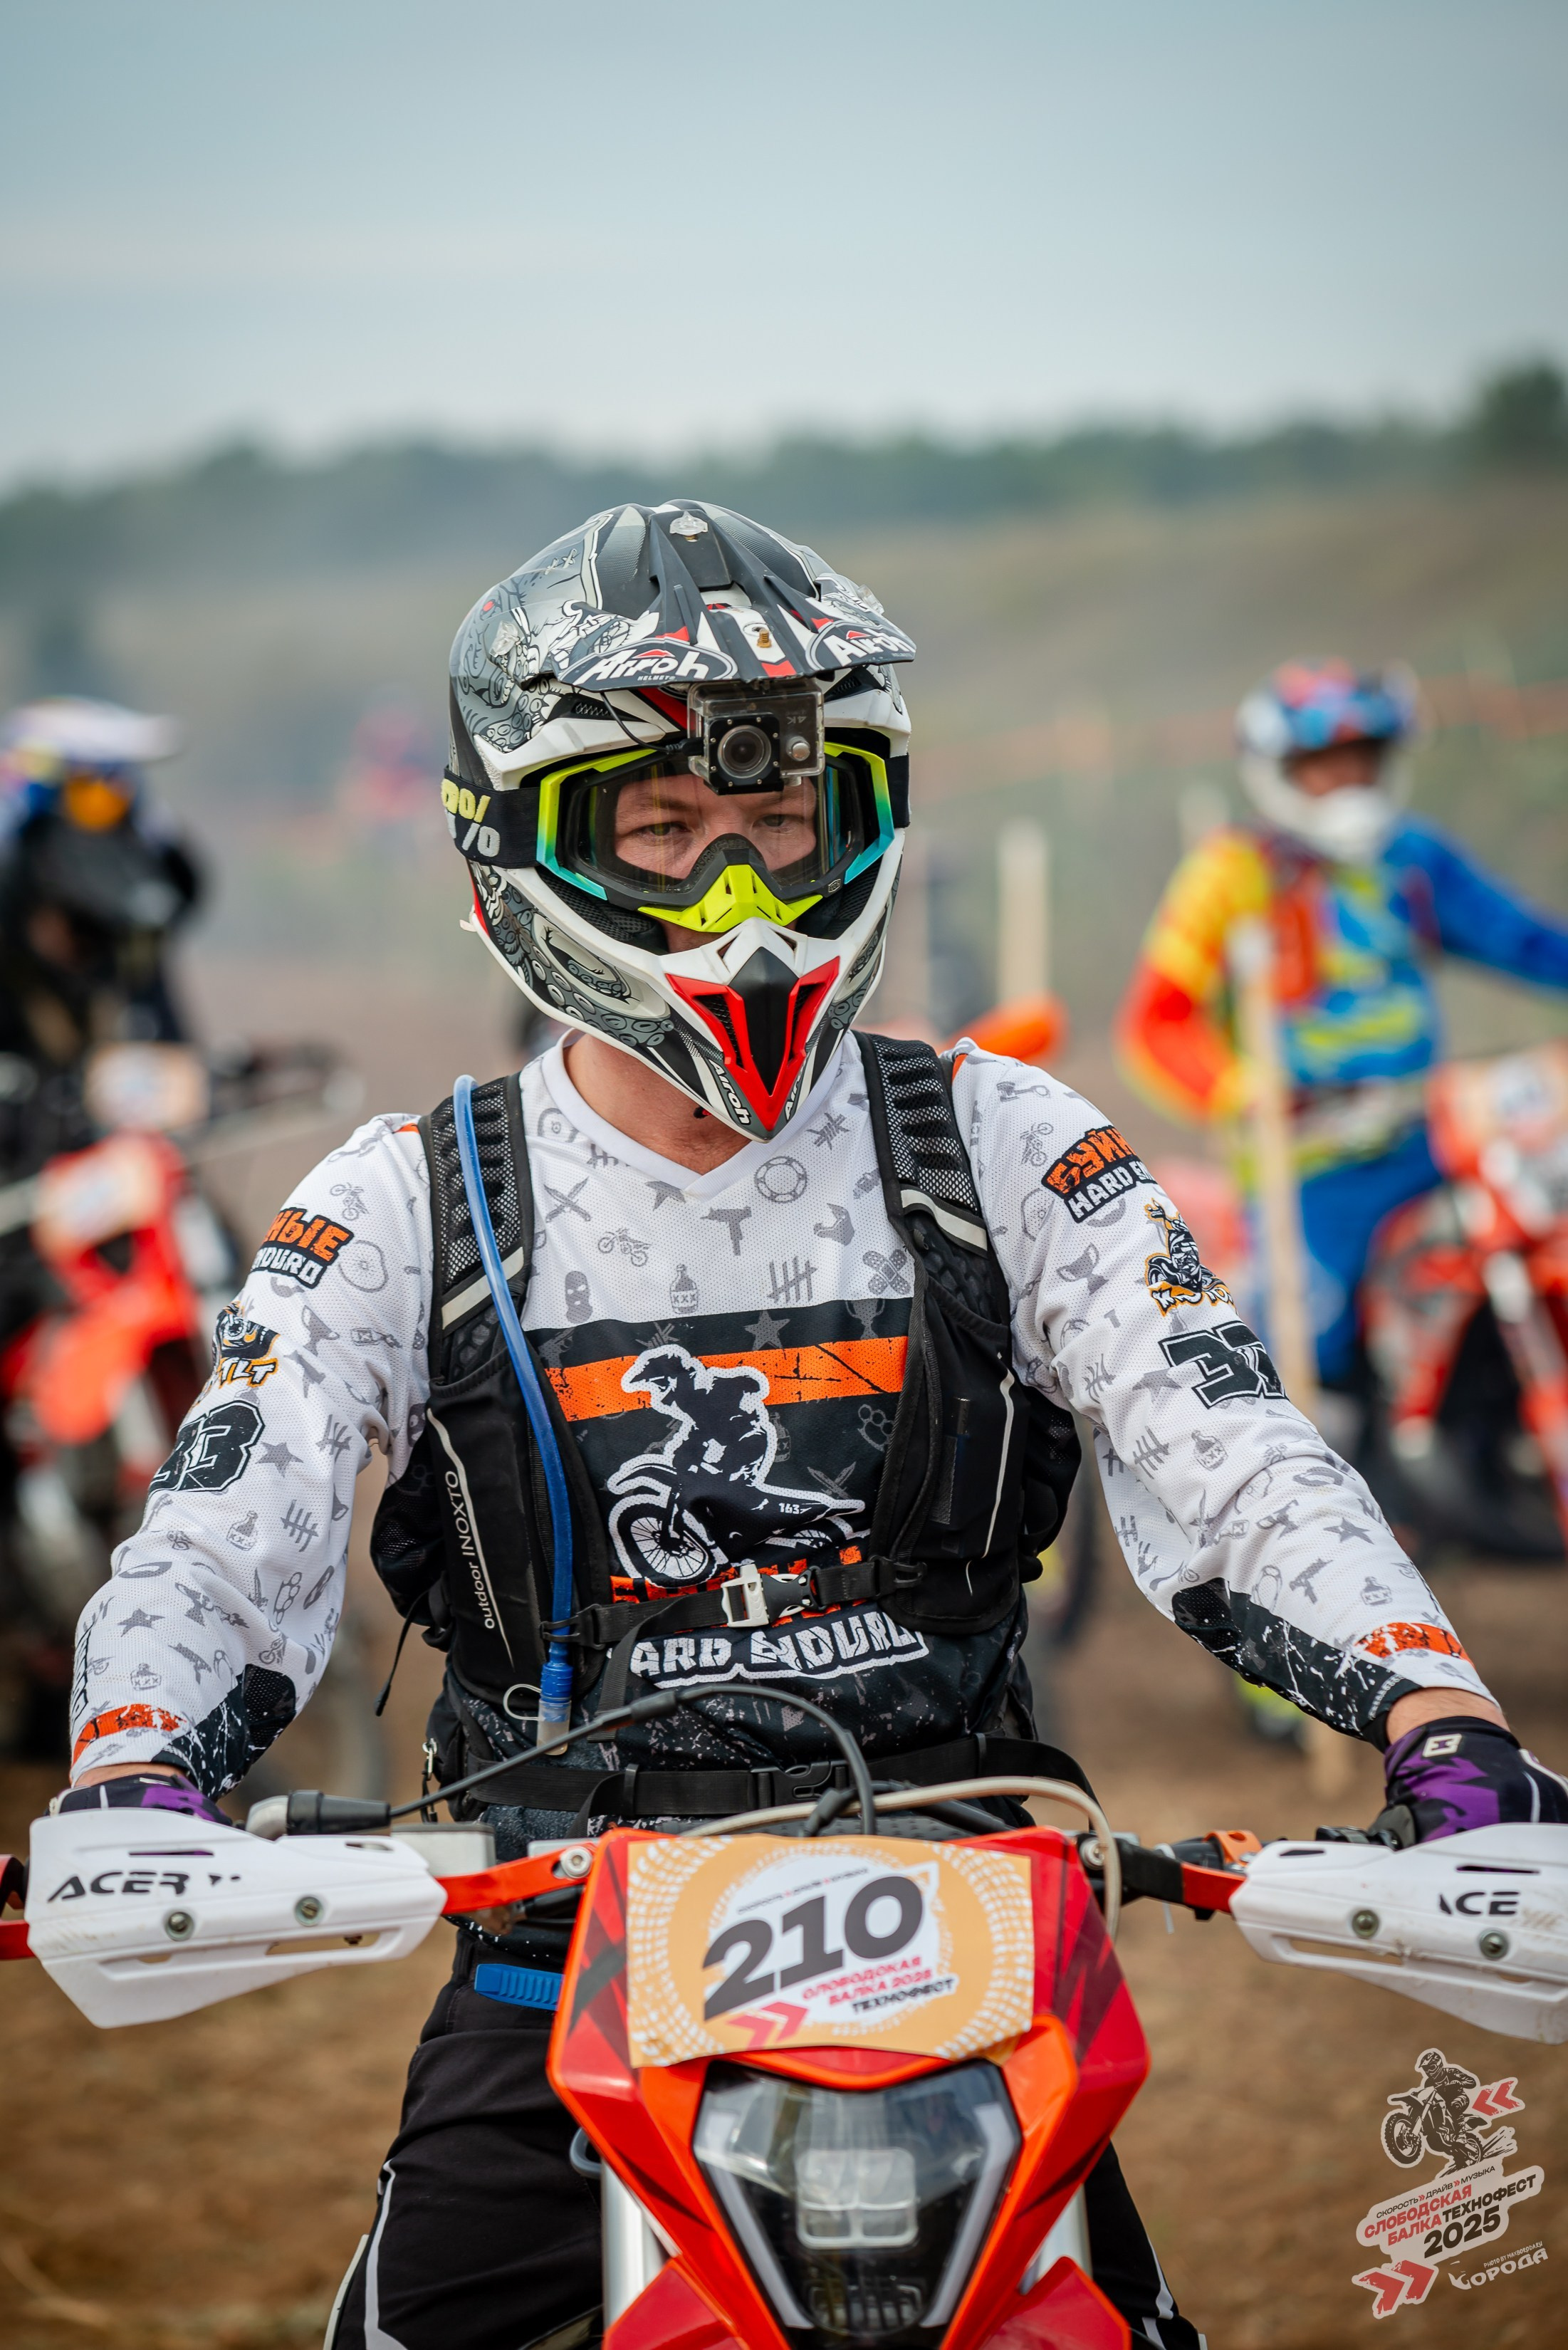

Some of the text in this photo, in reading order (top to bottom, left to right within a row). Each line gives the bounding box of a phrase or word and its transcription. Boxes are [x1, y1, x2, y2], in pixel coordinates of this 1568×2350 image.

[573, 649, 709, 685] Airoh
[708, 1058, 751, 1124] Airoh
[1068, 1166, 1134, 1218] HARD
[251, 1246, 323, 1285] NDURO
[444, 1471, 496, 1629] INOXTO outdoor
[629, 1637, 732, 1676] ARD
[47, 1869, 241, 1903] ACER
[702, 1876, 924, 2022] 210
